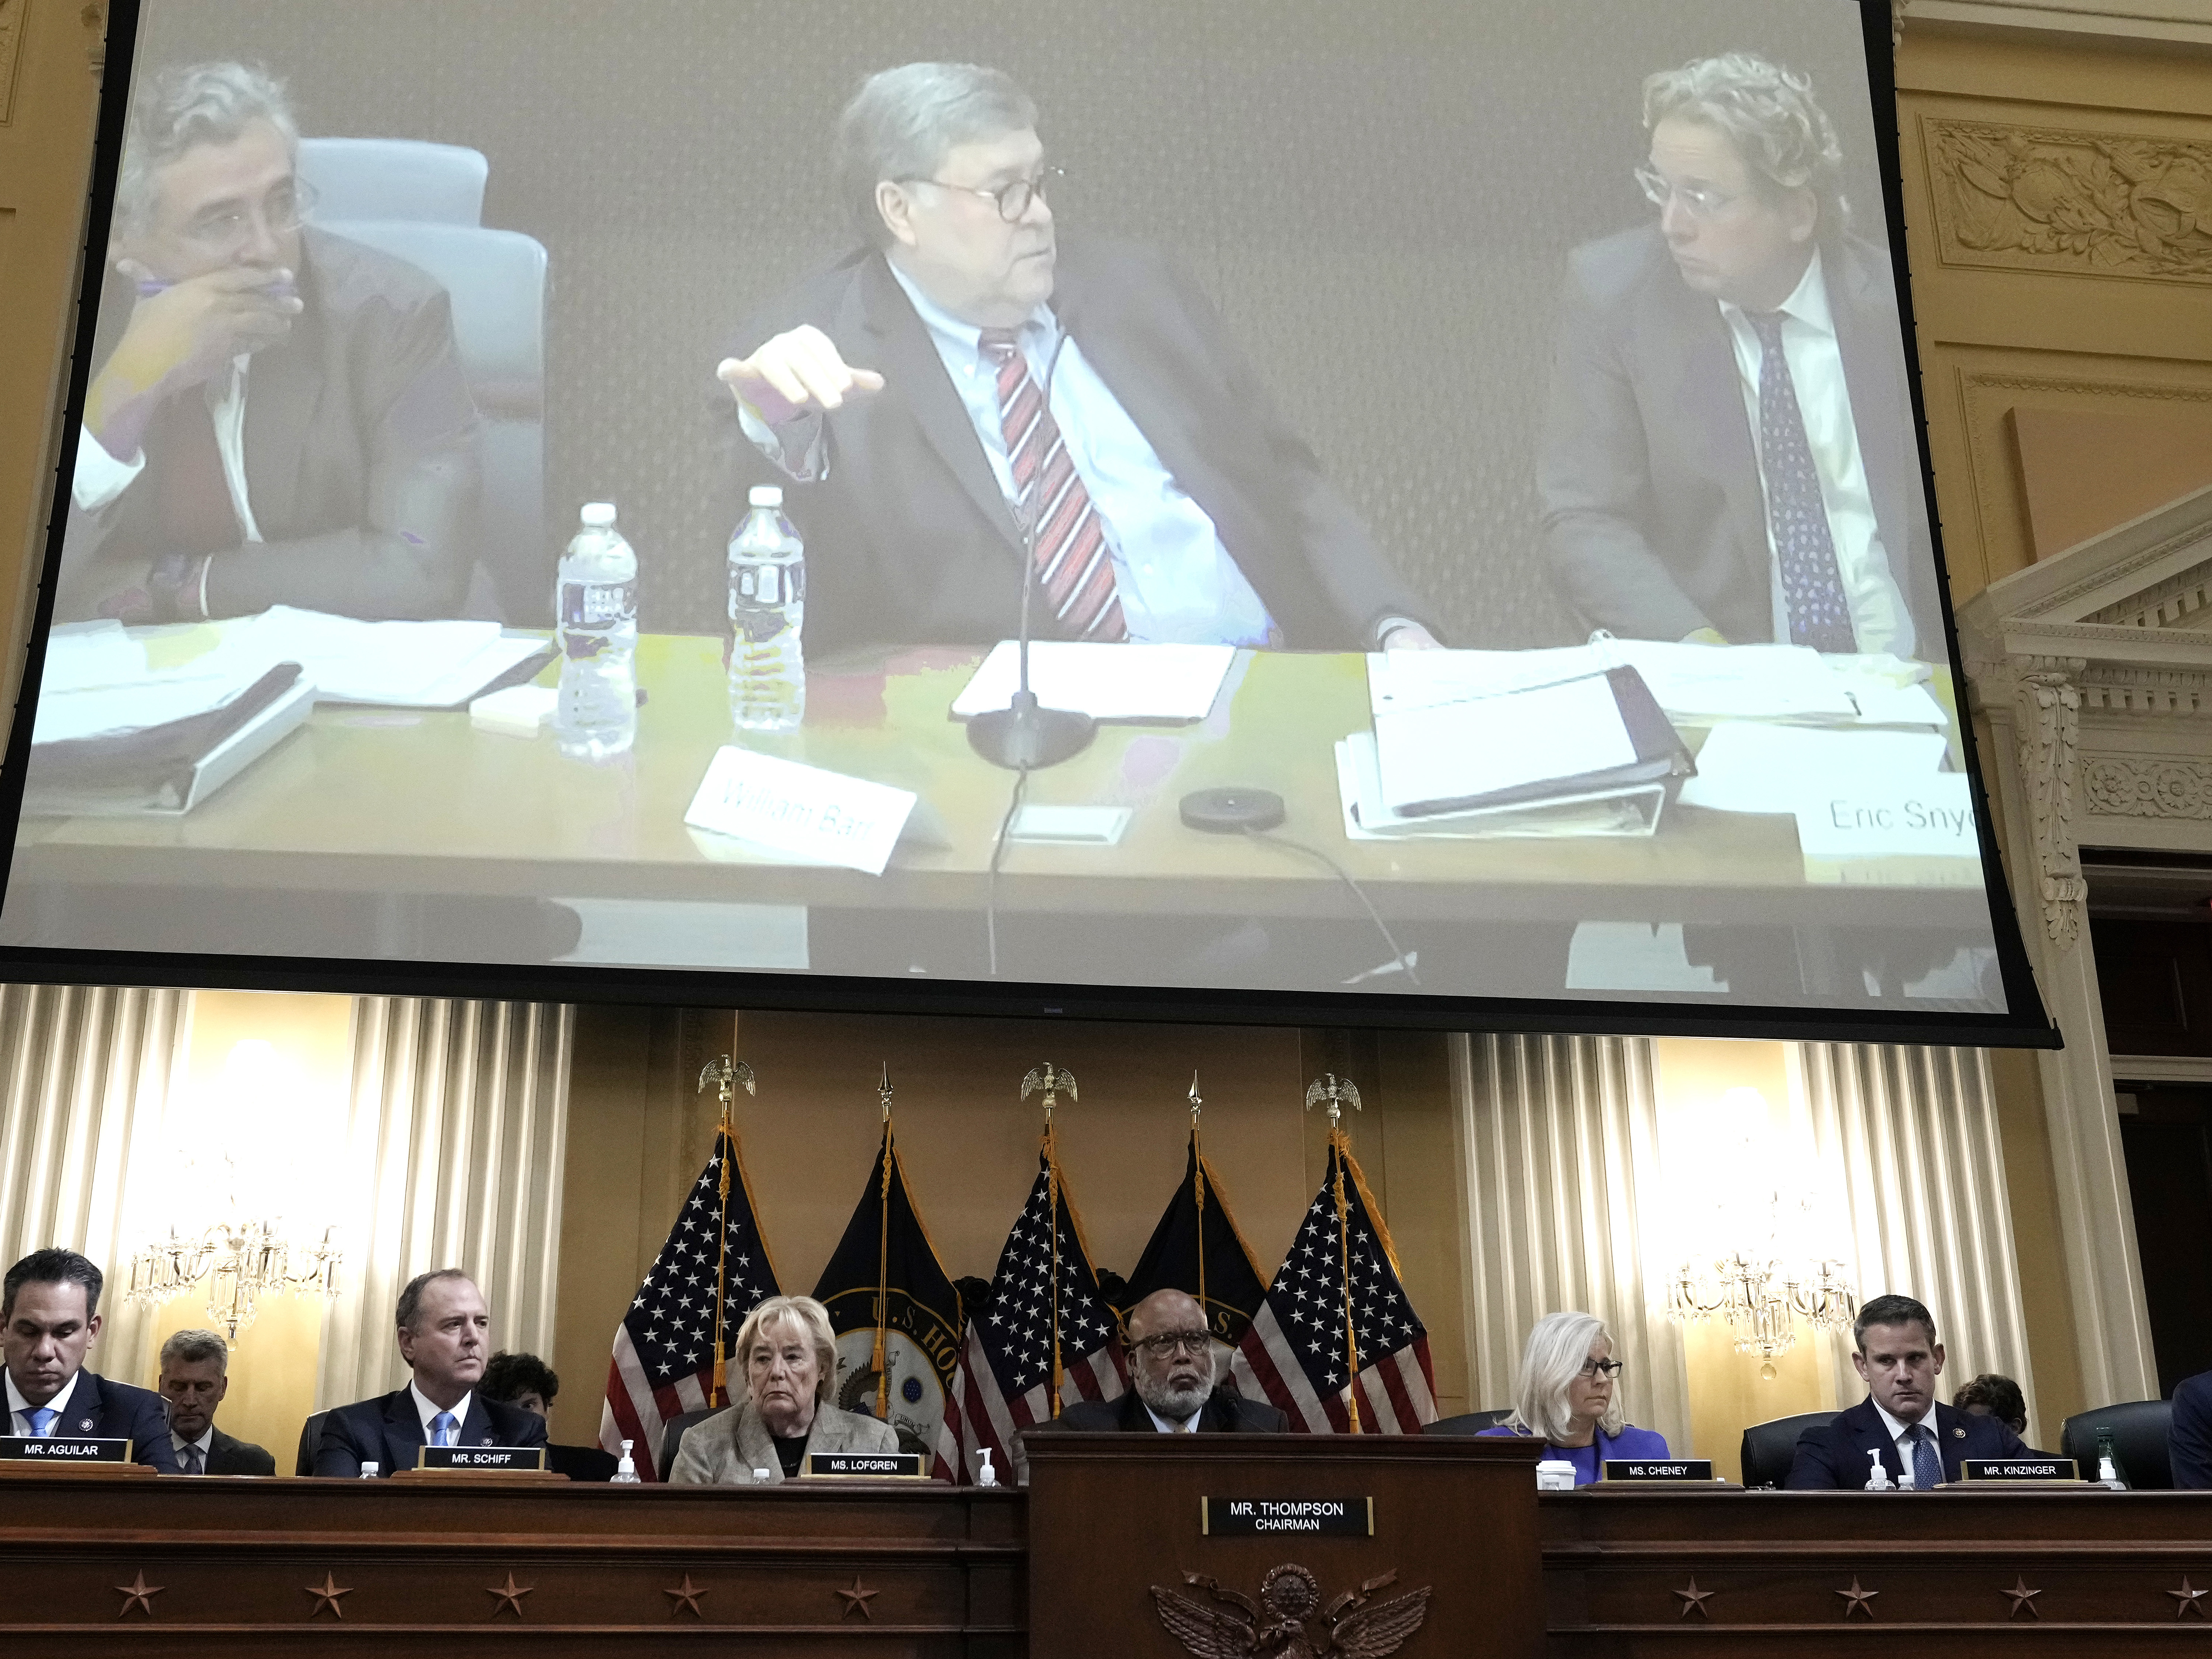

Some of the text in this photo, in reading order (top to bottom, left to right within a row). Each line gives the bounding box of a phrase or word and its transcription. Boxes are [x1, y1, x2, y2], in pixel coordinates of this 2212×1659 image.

[1830, 799, 1894, 830] Eric
[900, 1415, 915, 1428] UNUM
[25, 1444, 98, 1455] MR. AGUILAR
[452, 1453, 511, 1464] MR. SCHIFF
[831, 1460, 897, 1470] MS. LOFGREN
[1629, 1466, 1687, 1475] MS. CHENEY
[1984, 1466, 2056, 1475] MR. KINZINGER
[1231, 1502, 1343, 1515] MR. THOMPSON
[1256, 1519, 1320, 1530] CHAIRMAN
